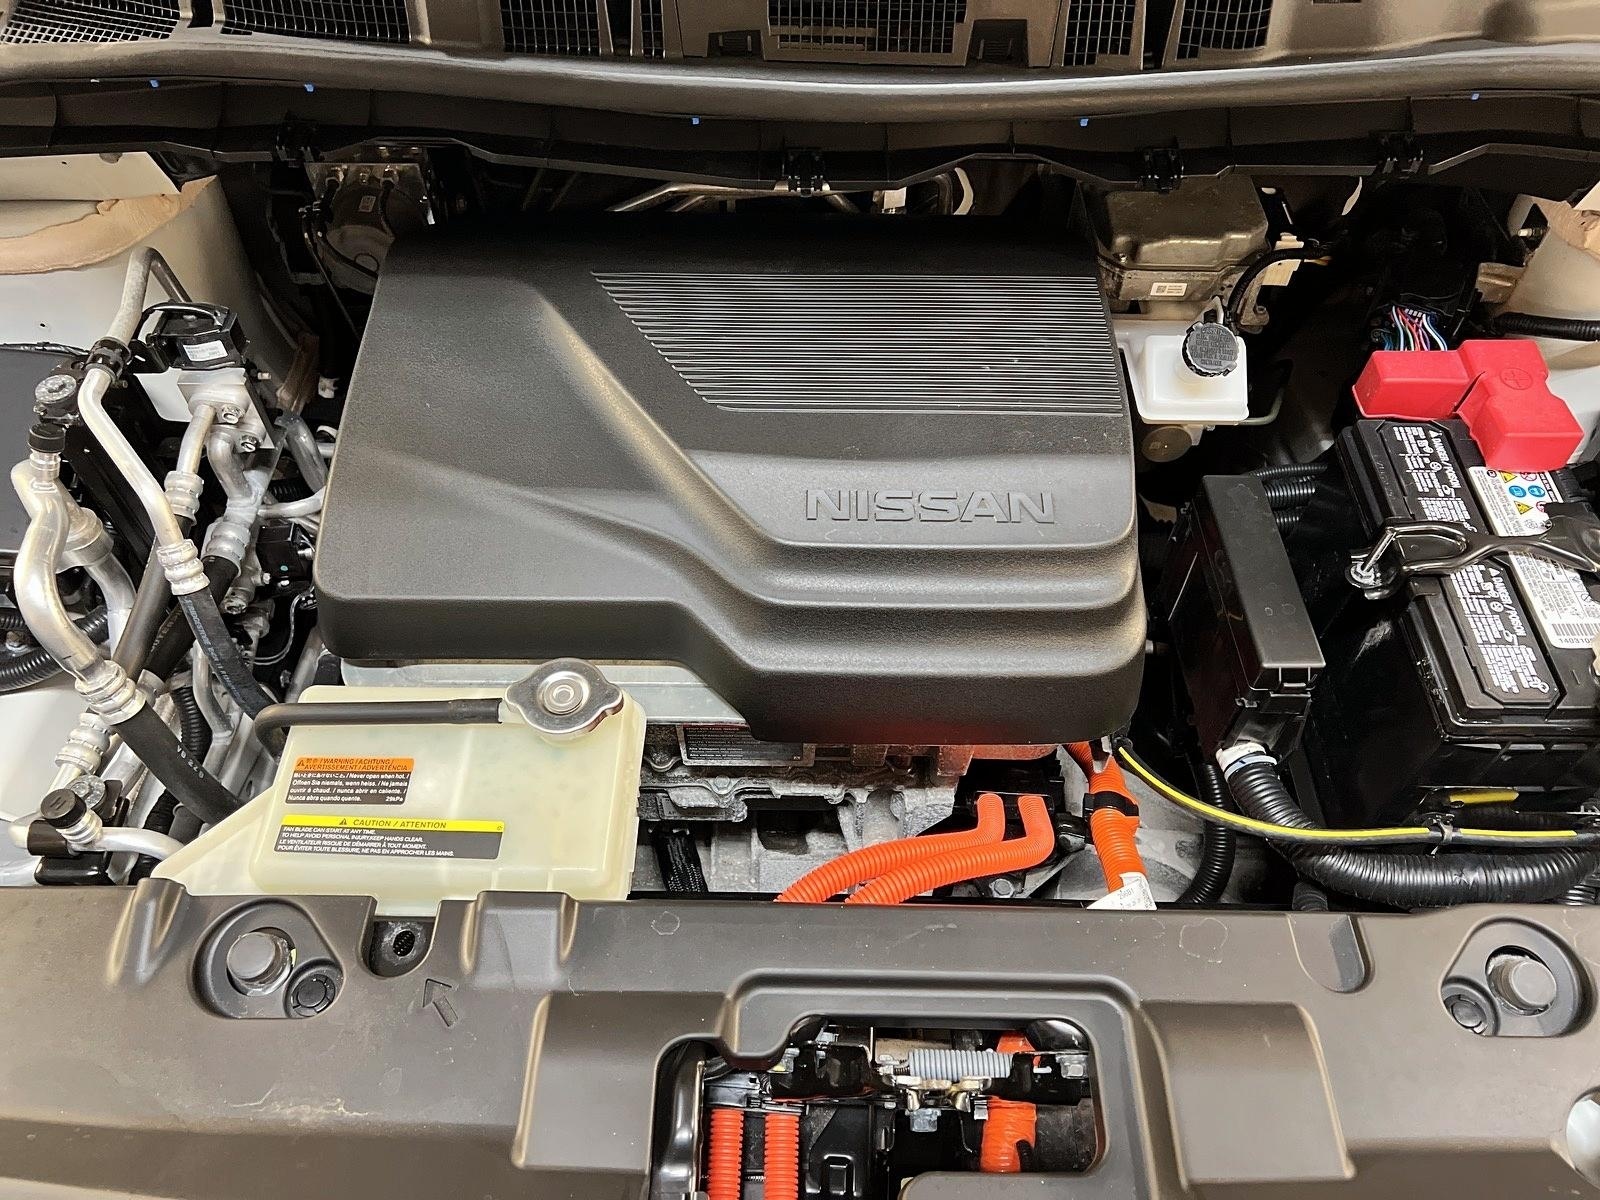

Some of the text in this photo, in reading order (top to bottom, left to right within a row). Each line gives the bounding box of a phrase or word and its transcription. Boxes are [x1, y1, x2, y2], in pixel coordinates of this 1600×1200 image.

[805, 489, 1055, 525] NISSAN
[352, 819, 392, 827] CAUTION
[399, 820, 447, 829] ATTENTION
